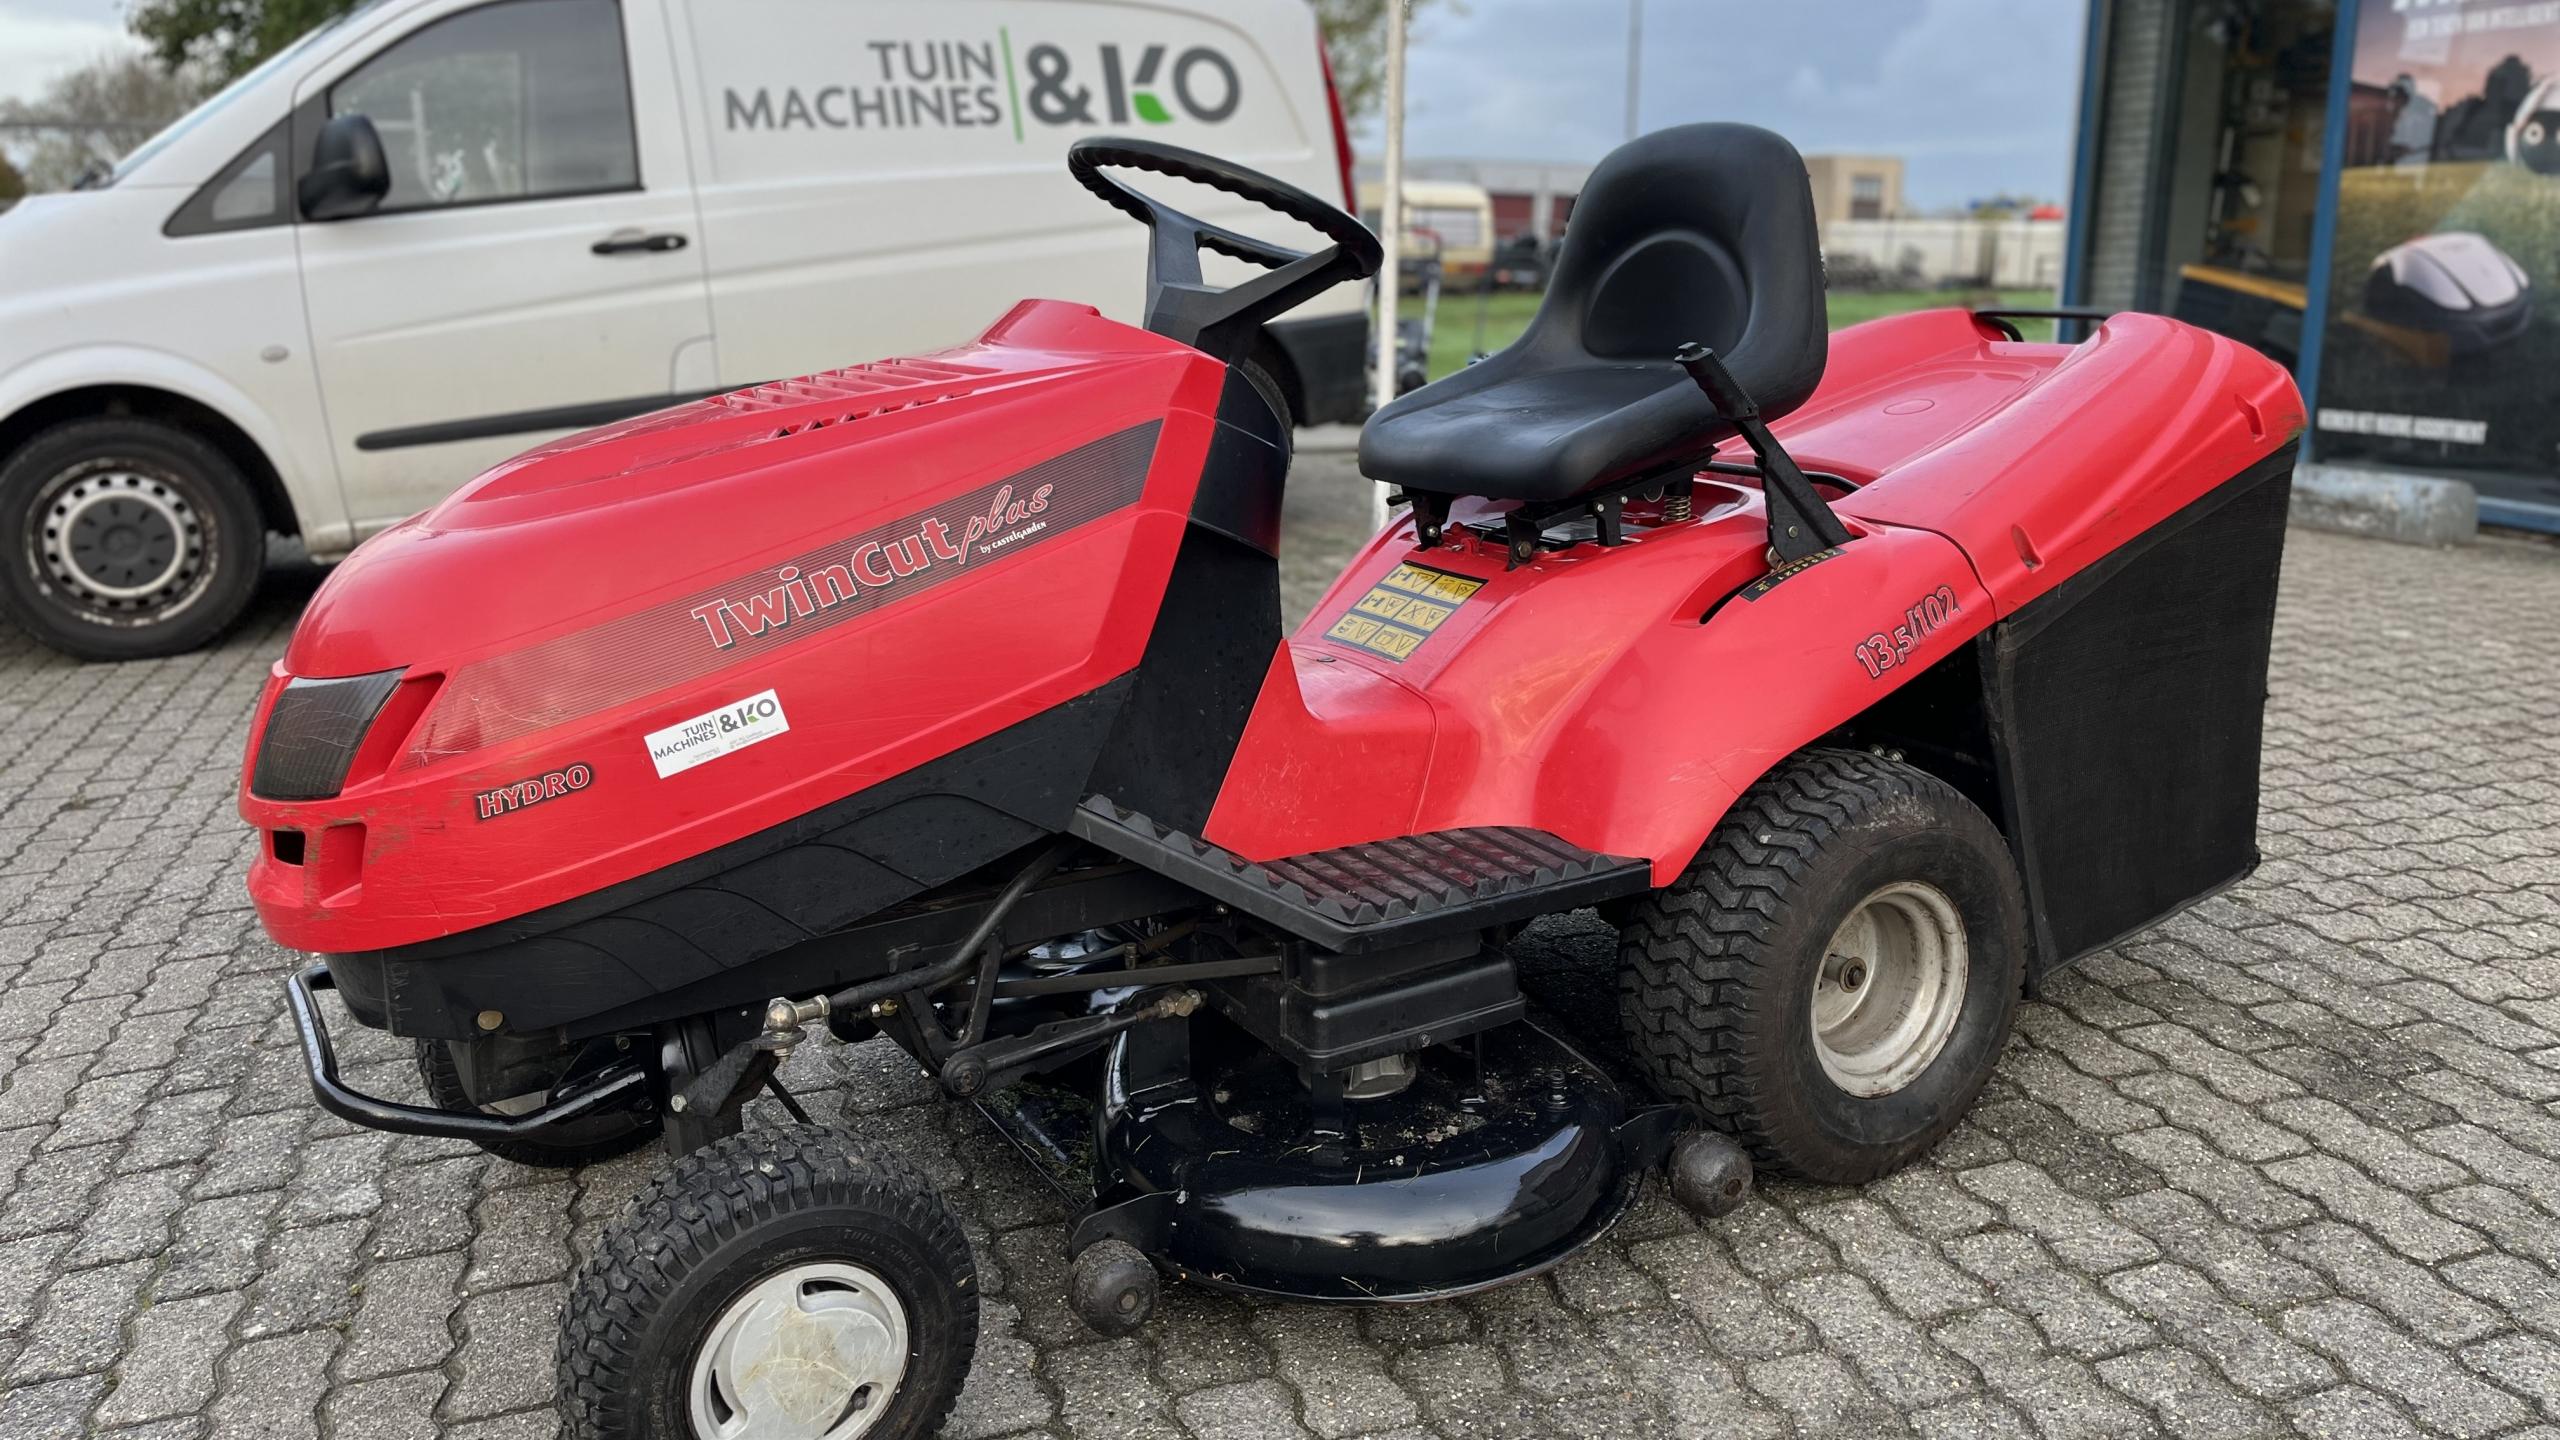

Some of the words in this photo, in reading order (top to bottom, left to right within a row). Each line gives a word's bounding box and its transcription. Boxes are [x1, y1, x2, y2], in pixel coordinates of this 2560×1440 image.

[866, 41, 996, 82] TUIN
[723, 85, 1002, 131] MACHINES
[690, 517, 960, 649] TwinCut
[958, 483, 1054, 565] plus
[980, 543, 992, 554] by
[1856, 586, 1962, 678] 13,5/102
[653, 729, 717, 760] MACHINES
[682, 719, 714, 738] TUIN
[478, 765, 590, 818] HYDRO
